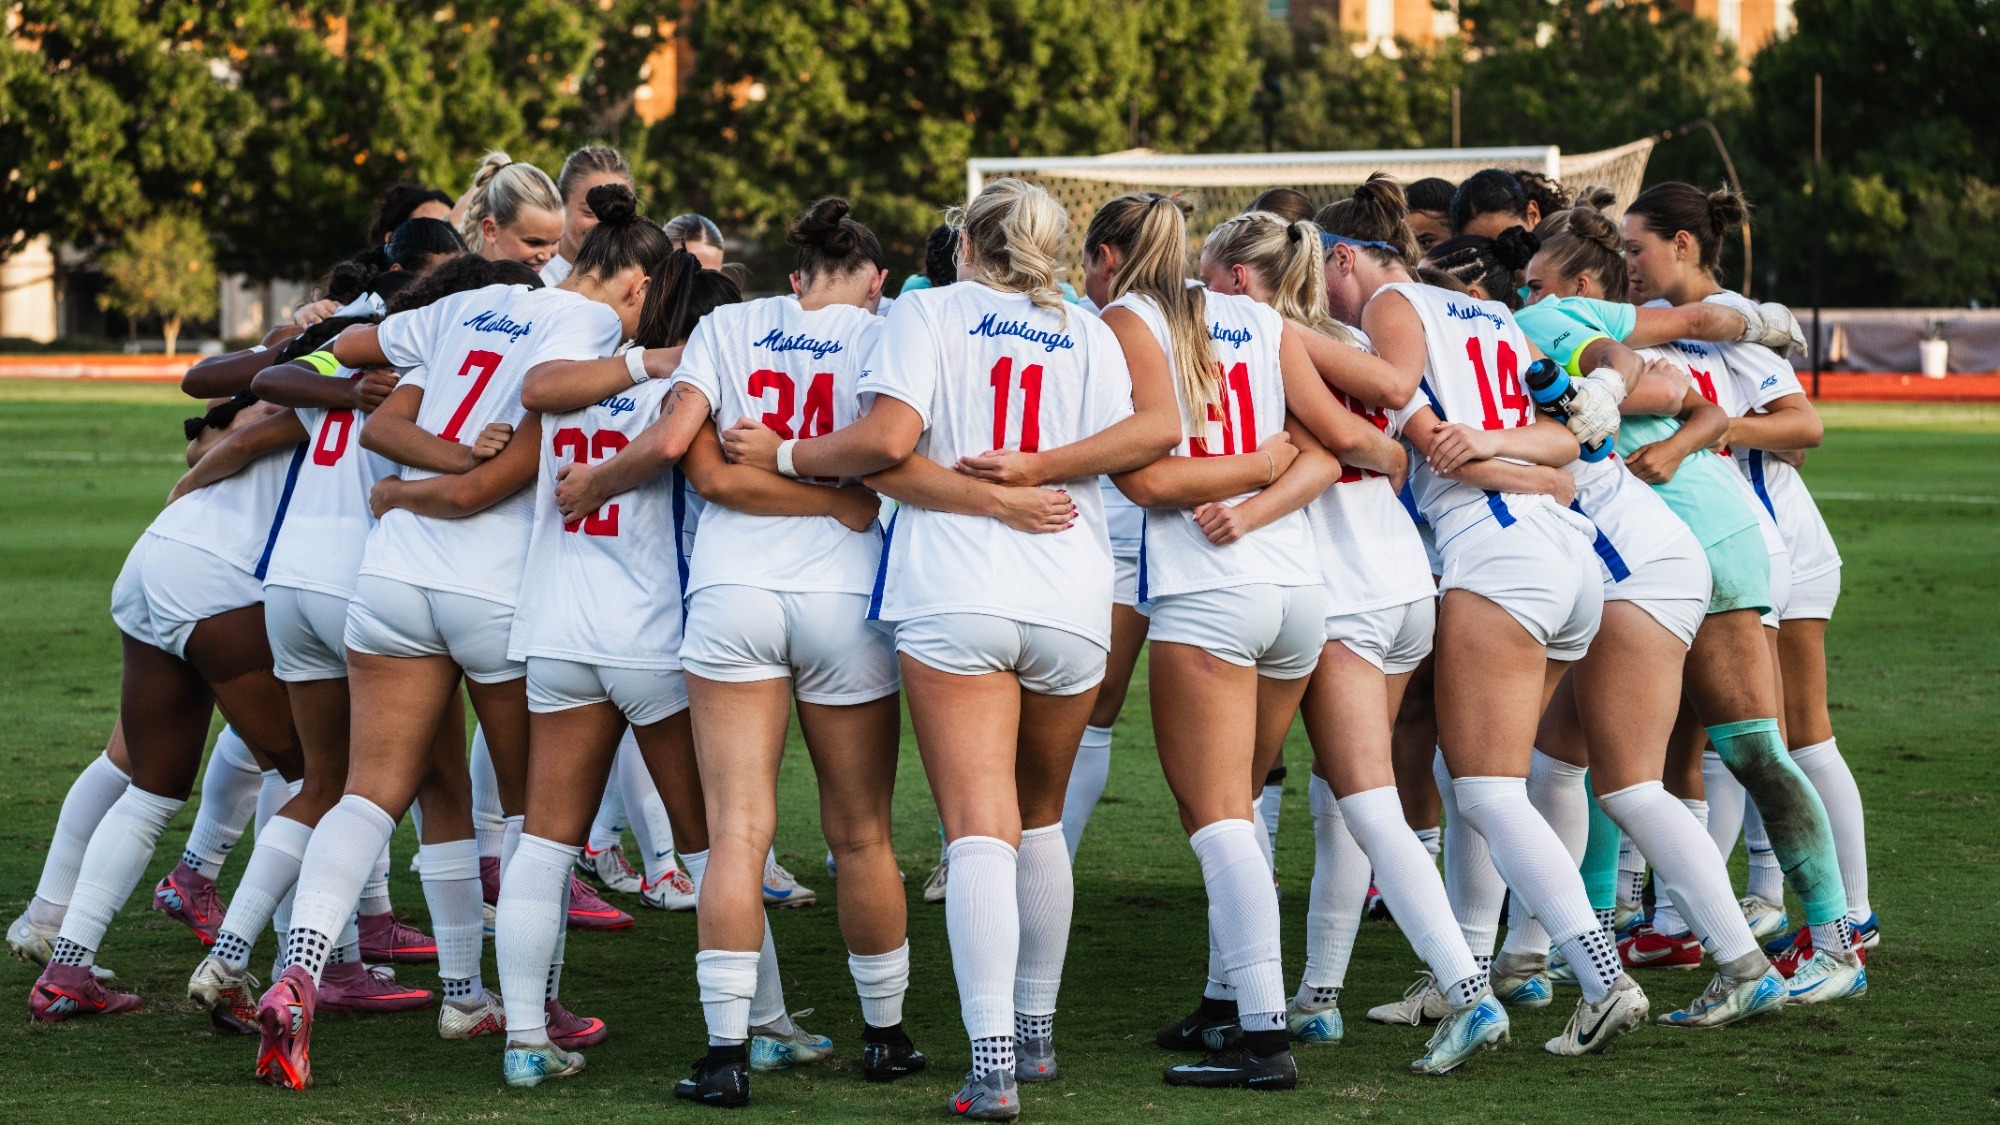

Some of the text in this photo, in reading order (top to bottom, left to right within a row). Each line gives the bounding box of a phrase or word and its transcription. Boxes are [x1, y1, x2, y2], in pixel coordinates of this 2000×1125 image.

[969, 313, 1075, 352] Mustangs
[1206, 321, 1252, 349] tangs
[1553, 331, 1571, 350] ACC
[437, 350, 503, 443] 7
[990, 356, 1043, 453] 11
[1465, 336, 1530, 431] 14
[1759, 374, 1778, 391] ACC
[747, 369, 834, 482] 34
